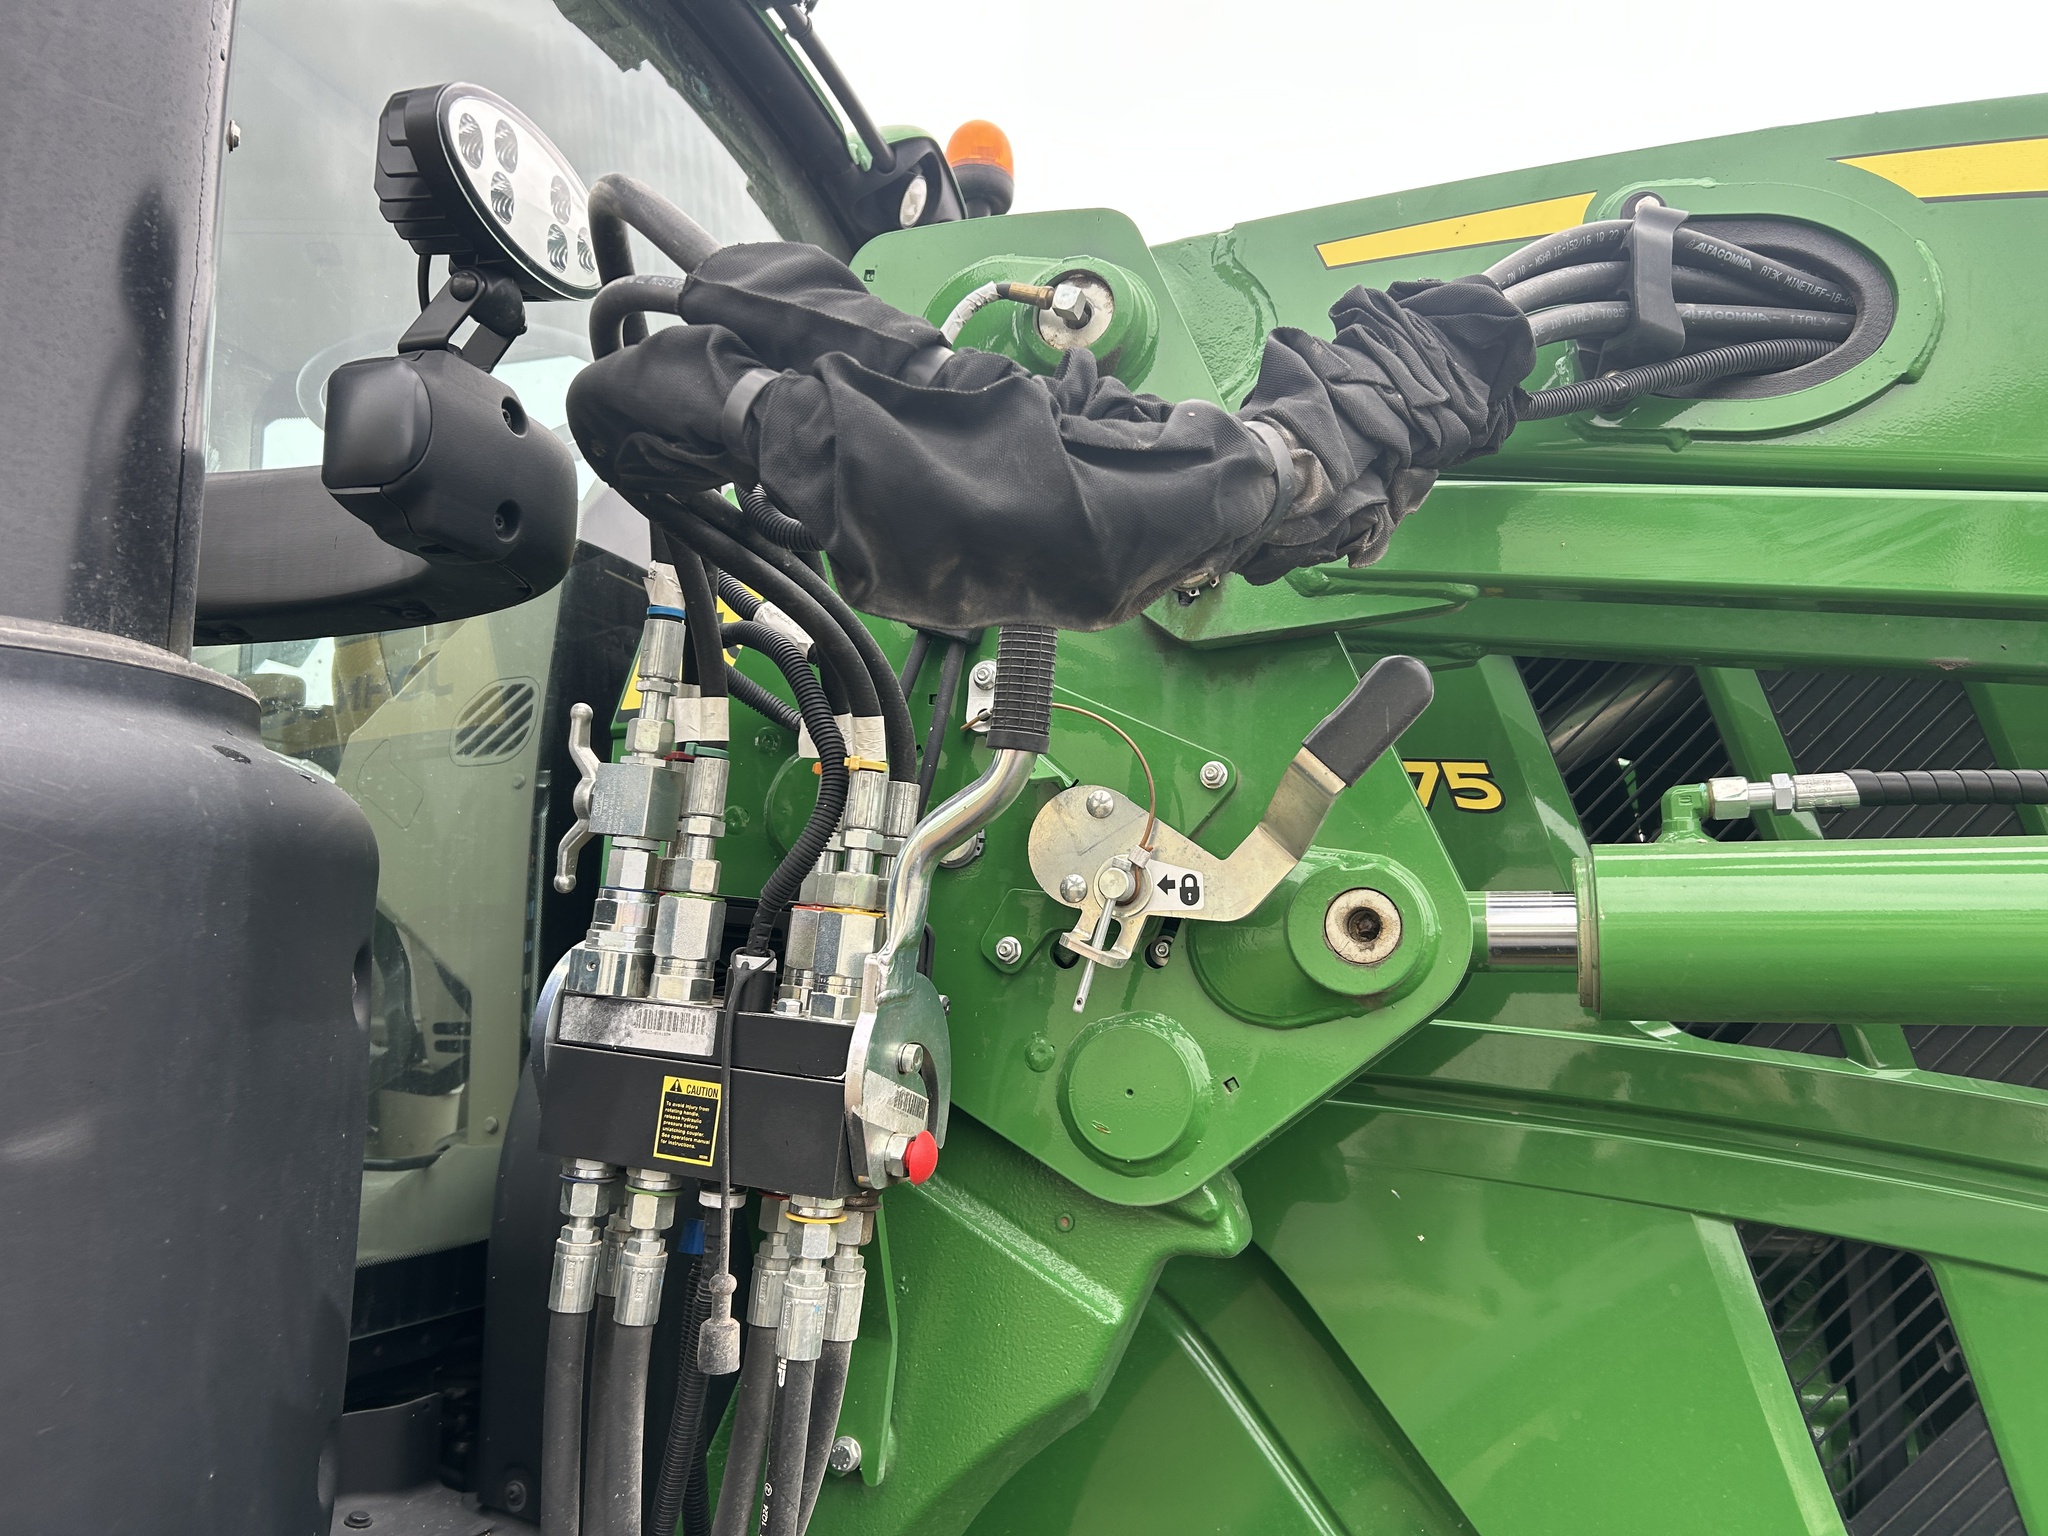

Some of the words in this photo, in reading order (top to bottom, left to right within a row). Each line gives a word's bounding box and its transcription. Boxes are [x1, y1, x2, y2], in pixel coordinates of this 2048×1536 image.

[1609, 229, 1619, 240] 22
[1693, 242, 1752, 271] ALFAGOMMA
[1759, 265, 1782, 282] AT3K
[1790, 314, 1831, 326] ITALY
[1402, 758, 1506, 814] 75
[686, 1084, 719, 1098] CAUTION
[681, 1116, 702, 1124] hydraulic
